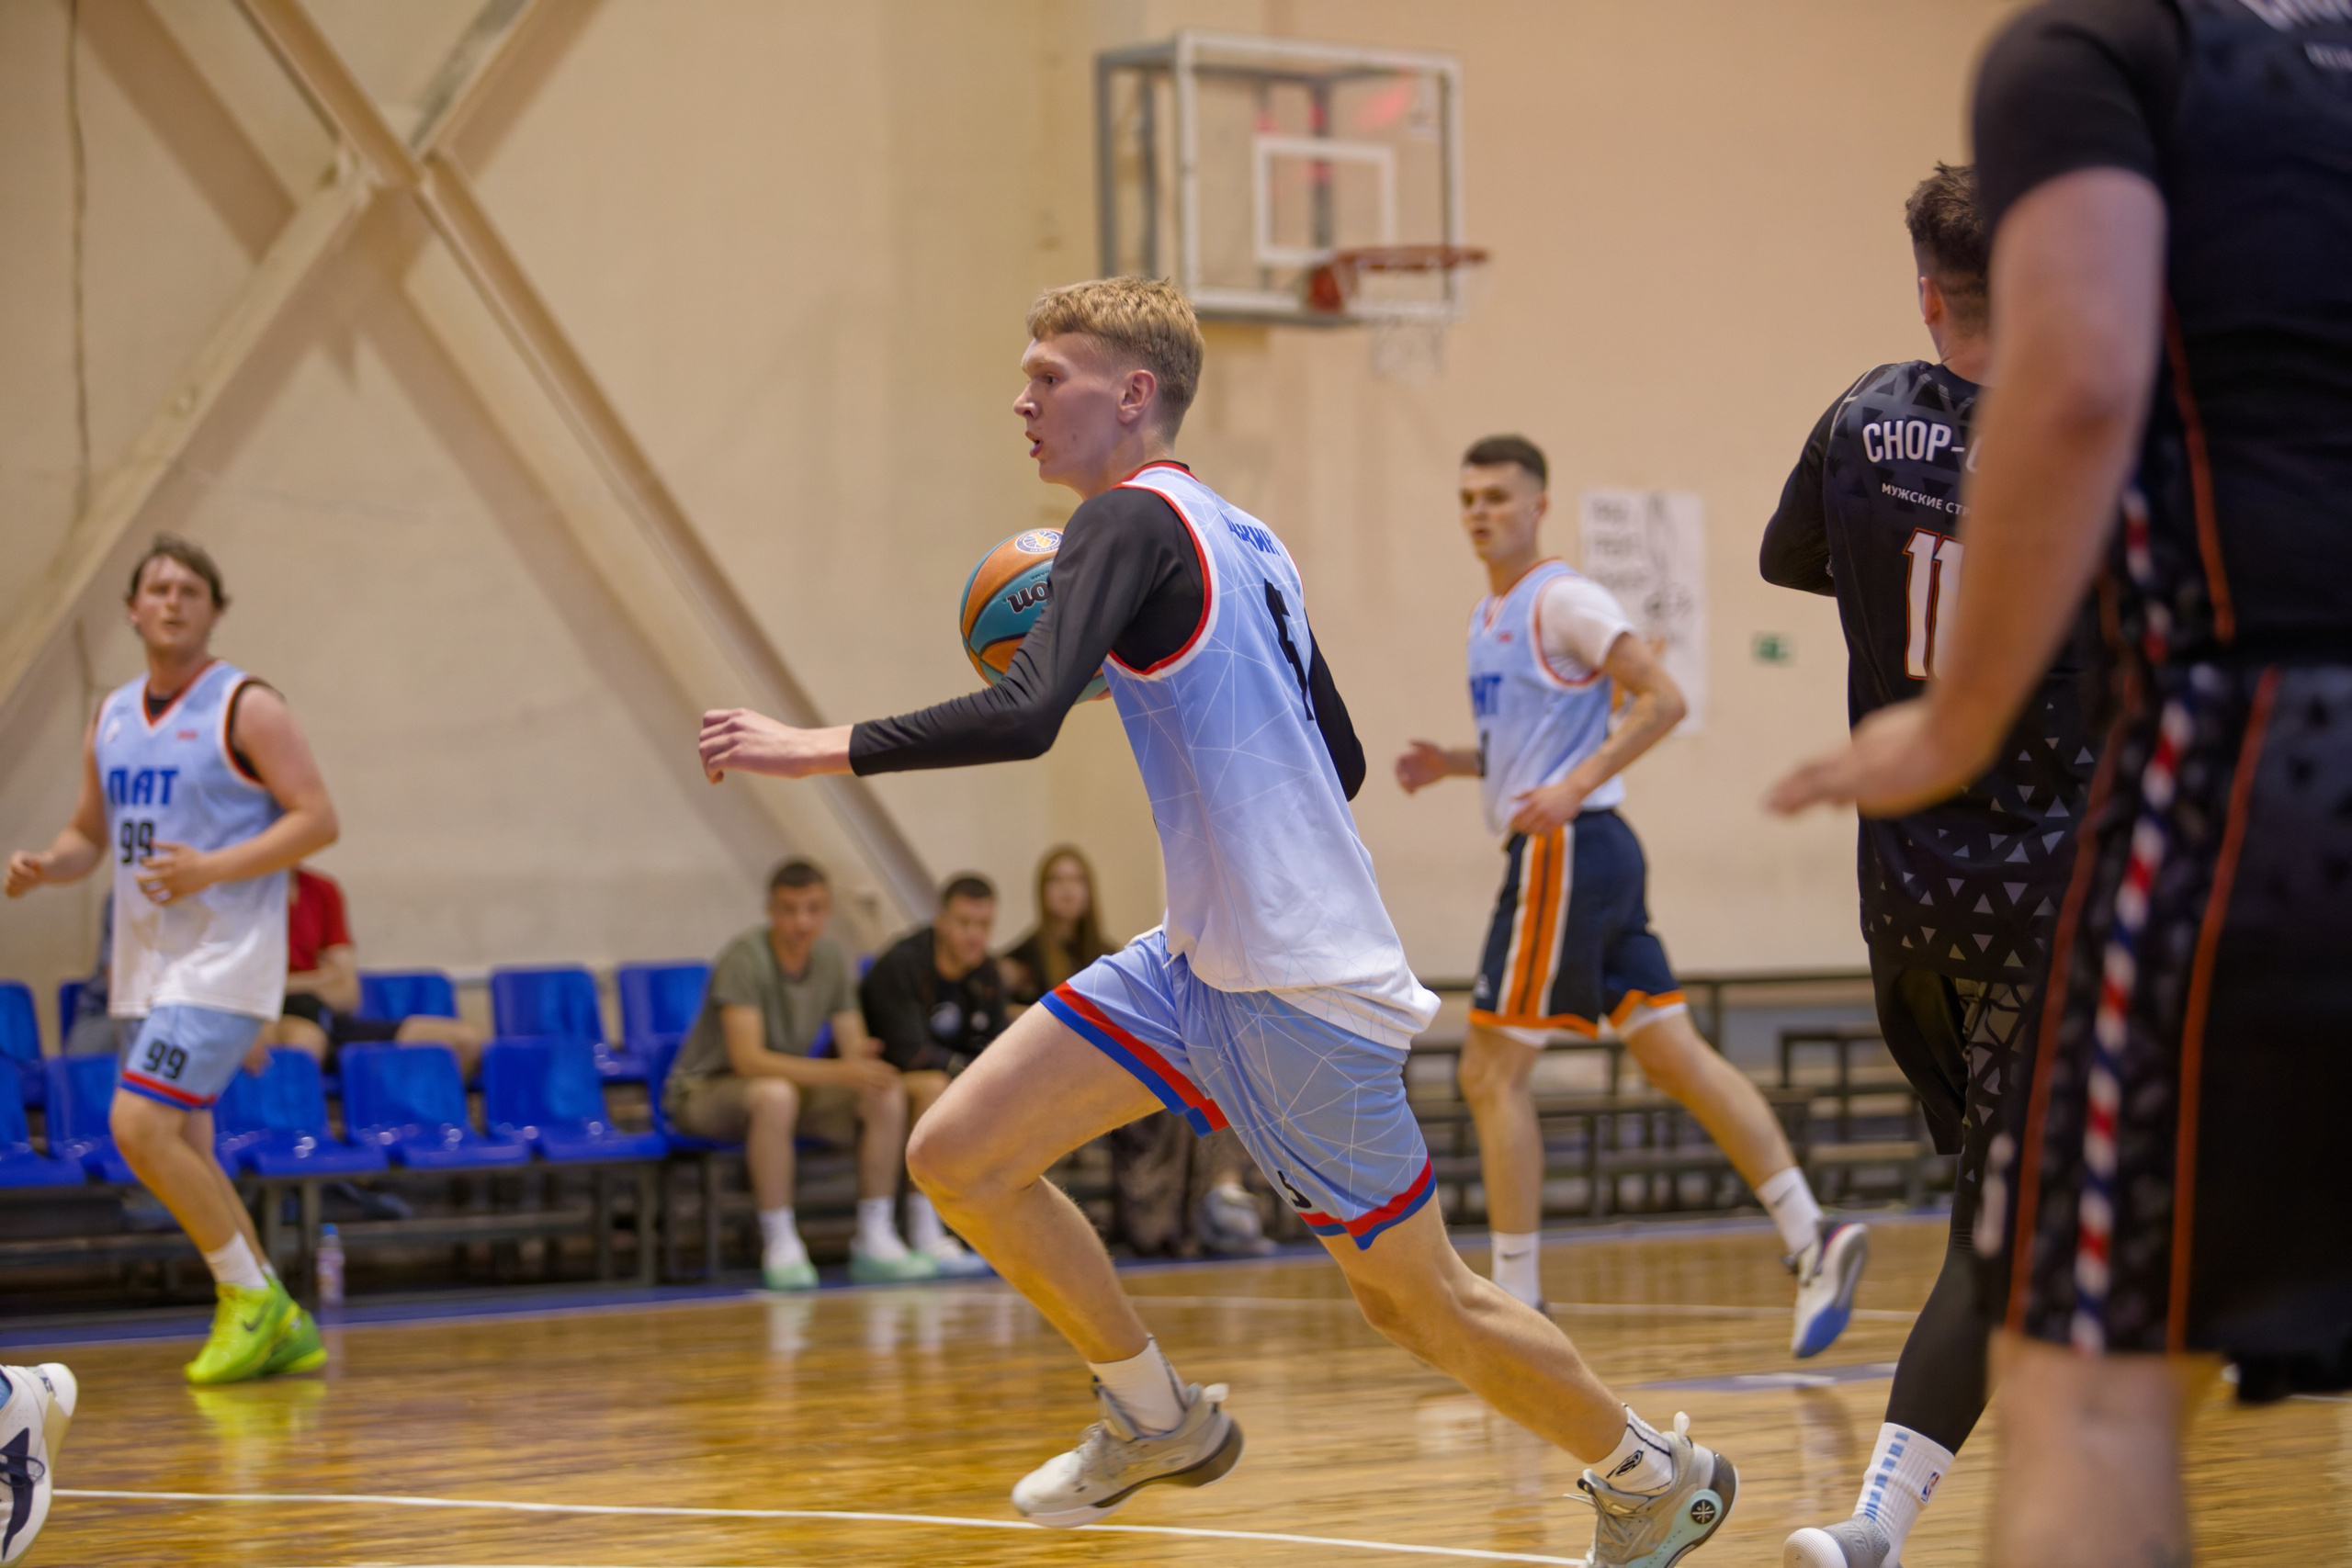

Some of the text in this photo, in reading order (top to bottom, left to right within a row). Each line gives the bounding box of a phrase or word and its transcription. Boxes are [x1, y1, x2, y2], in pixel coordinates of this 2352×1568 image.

[1882, 482, 1971, 516] МУЖСКИЕ СТР
[1903, 527, 1965, 680] 11
[120, 820, 153, 864] 99
[143, 1040, 187, 1080] 99
